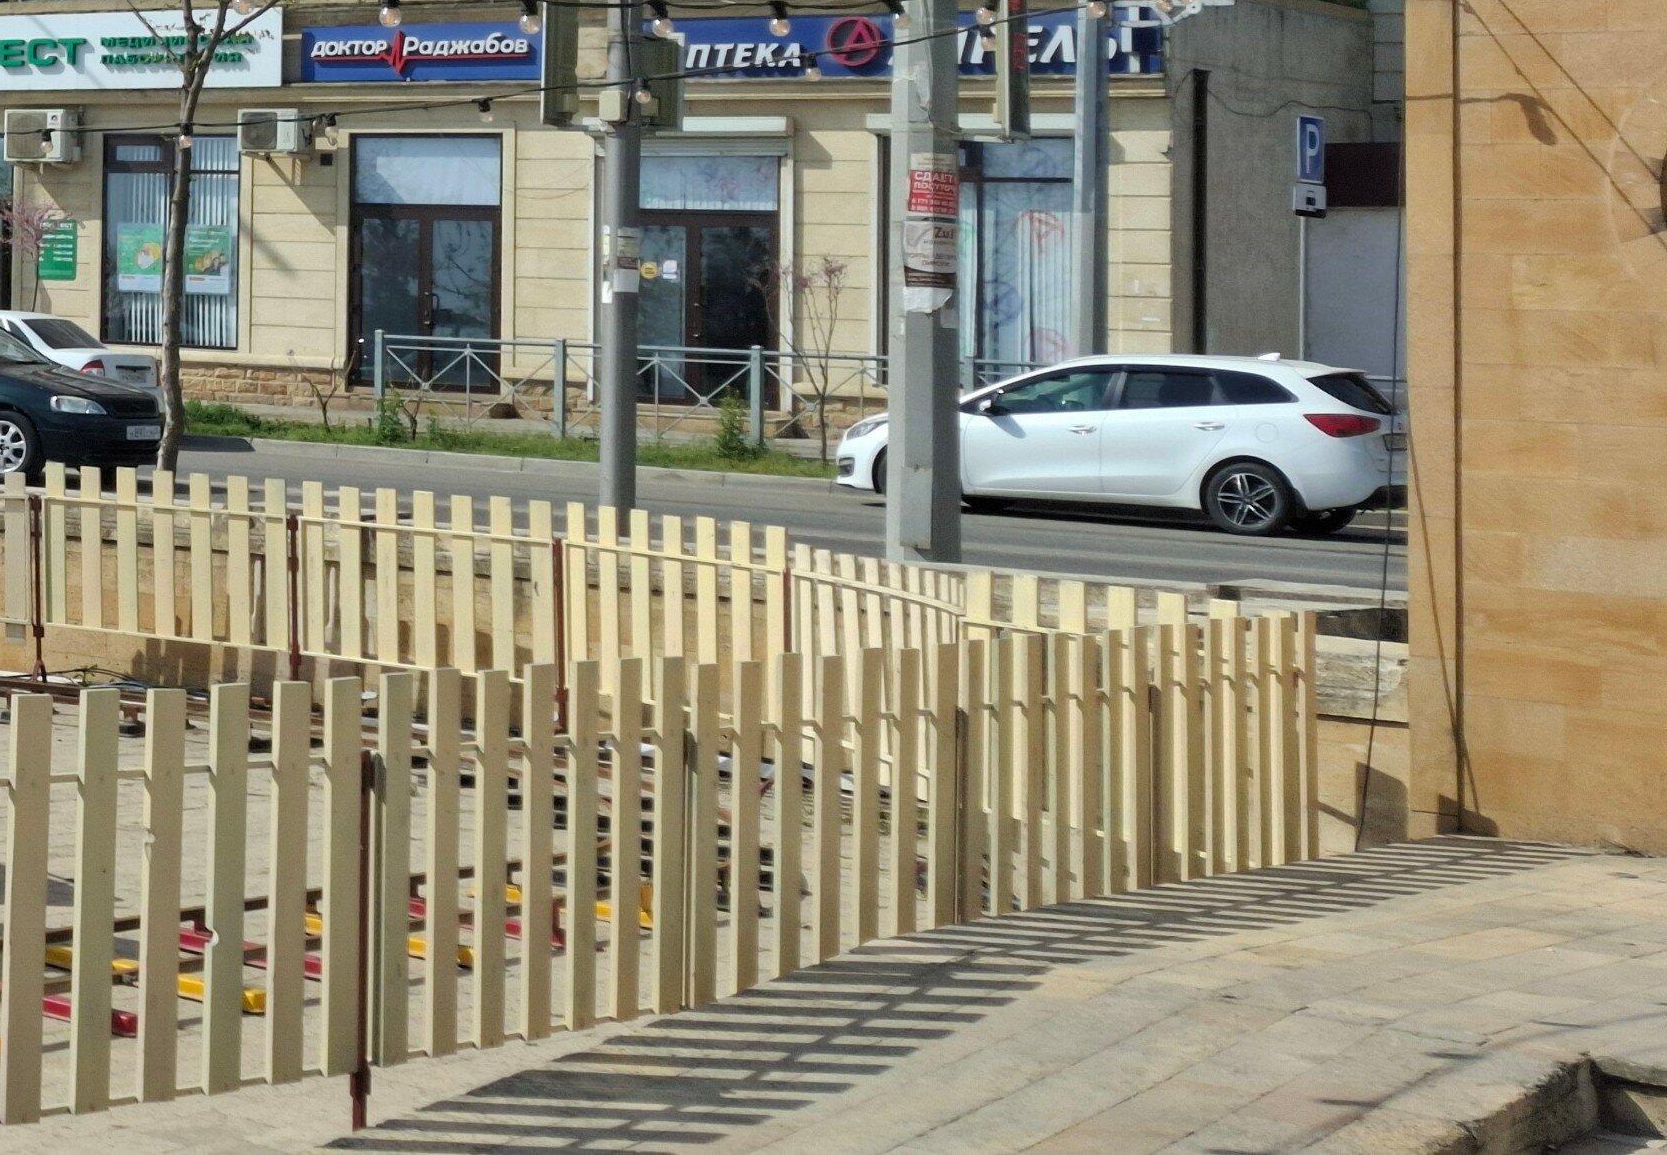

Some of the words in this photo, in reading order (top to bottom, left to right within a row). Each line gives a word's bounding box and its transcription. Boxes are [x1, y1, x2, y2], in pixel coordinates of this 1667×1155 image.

[403, 32, 528, 57] Раджабов
[667, 33, 801, 68] ПТЕКА
[1306, 123, 1319, 174] P
